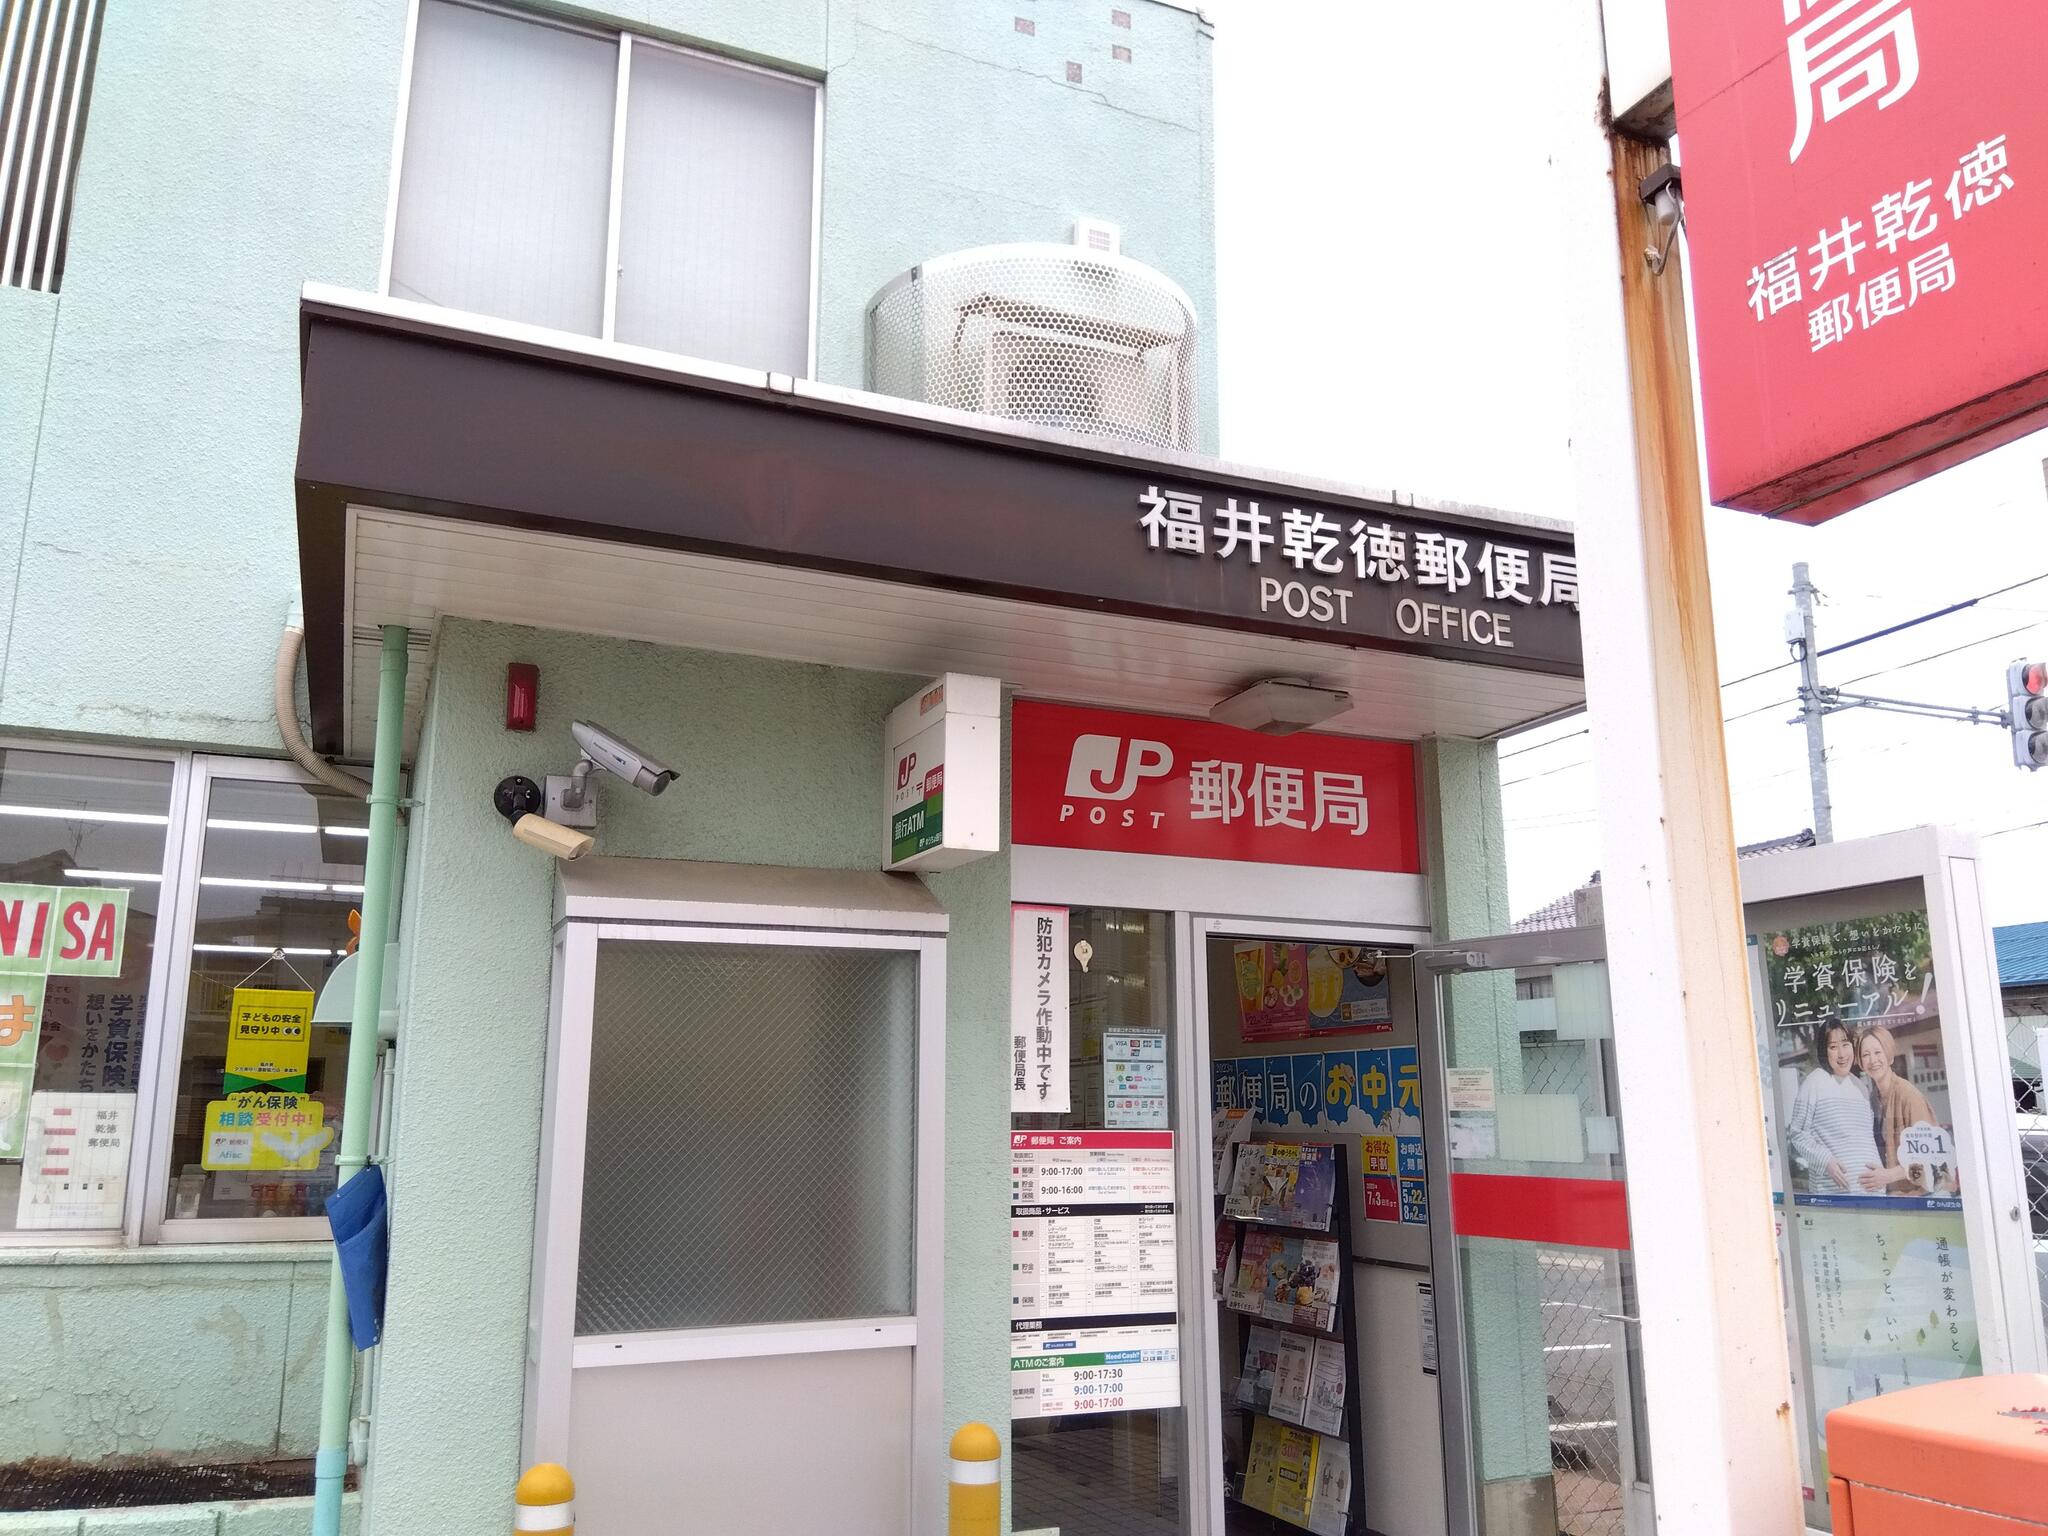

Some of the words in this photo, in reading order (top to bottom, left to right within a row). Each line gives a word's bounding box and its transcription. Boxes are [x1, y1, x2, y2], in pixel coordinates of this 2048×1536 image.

[1782, 0, 1920, 164] 局
[1746, 134, 2016, 322] 福井乾徳
[1807, 242, 1957, 353] 郵便局
[1138, 485, 1580, 611] 福井乾徳郵便局
[1260, 577, 1353, 624] POST
[1395, 598, 1514, 648] OFFICE
[926, 770, 944, 792] 郵便局
[1189, 759, 1370, 836] 郵便局
[895, 810, 925, 841] 銀行ATM
[1059, 804, 1166, 829] POST
[1783, 953, 1917, 994] 学資保険を
[242, 1012, 302, 1024] 子どもの安全
[1035, 917, 1054, 1100] 防犯カメラ作動中です
[240, 1025, 280, 1035] 見守り中
[103, 993, 134, 1093] 学資保険
[1013, 1036, 1027, 1091] 郵便局長
[1216, 1065, 1420, 1115] 郵便局のお中元
[96, 1110, 119, 1120] 福井
[88, 1137, 121, 1148] 郵便局
[1365, 1141, 1390, 1154] お得な
[1906, 1134, 1948, 1154] No.1
[1041, 1167, 1083, 1176] 9:00-17:00
[1370, 1157, 1388, 1170] 早割
[1041, 1186, 1083, 1195] 9:00-16:00
[1935, 1236, 1964, 1359] 通帳が変わると、
[1013, 1357, 1065, 1369] ATMのご案内
[1074, 1368, 1123, 1381] 9:00-17:30
[1074, 1382, 1123, 1395] 9:00-17:00
[1074, 1397, 1124, 1410] 9:00-17:00
